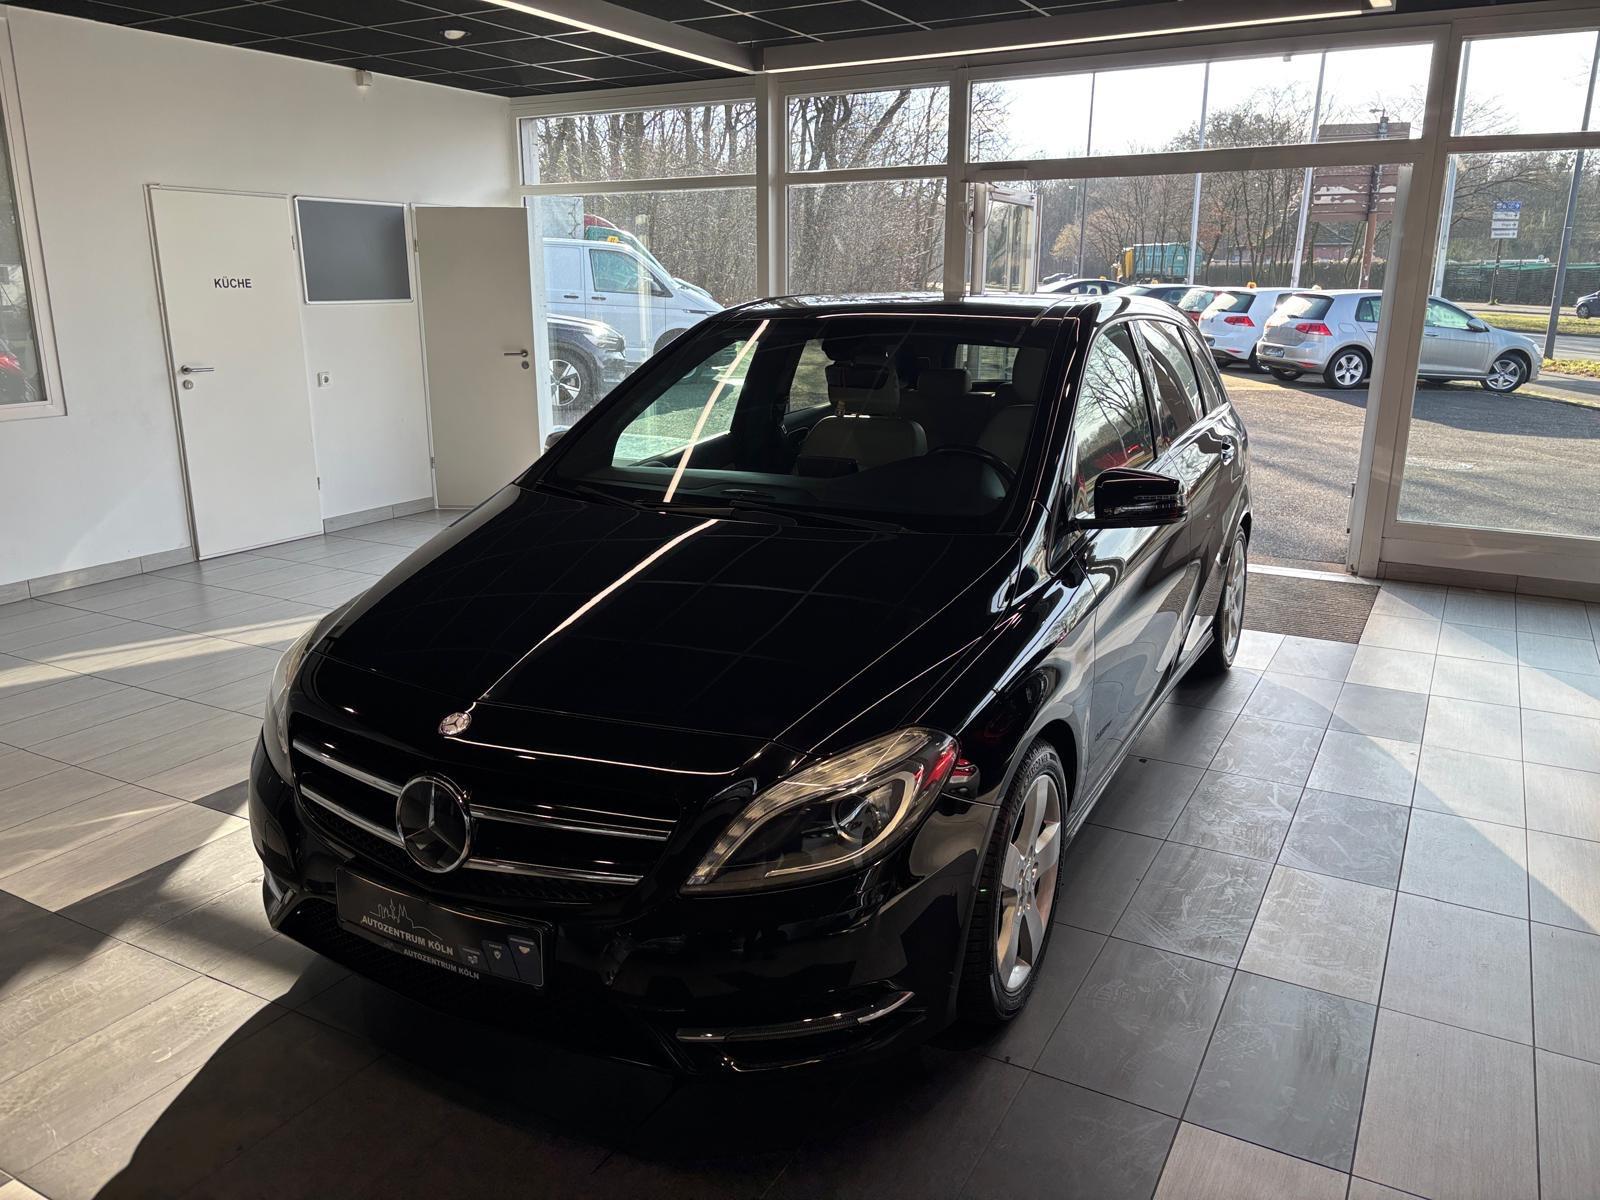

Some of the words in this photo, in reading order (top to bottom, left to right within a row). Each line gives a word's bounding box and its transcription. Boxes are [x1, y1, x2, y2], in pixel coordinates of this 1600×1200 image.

[213, 275, 252, 289] KÜCHE
[361, 915, 426, 947] AUTOZENTRUM
[428, 936, 454, 956] KÖLN
[403, 948, 457, 973] AUTOZENTRUM
[458, 966, 480, 980] KÖLN
